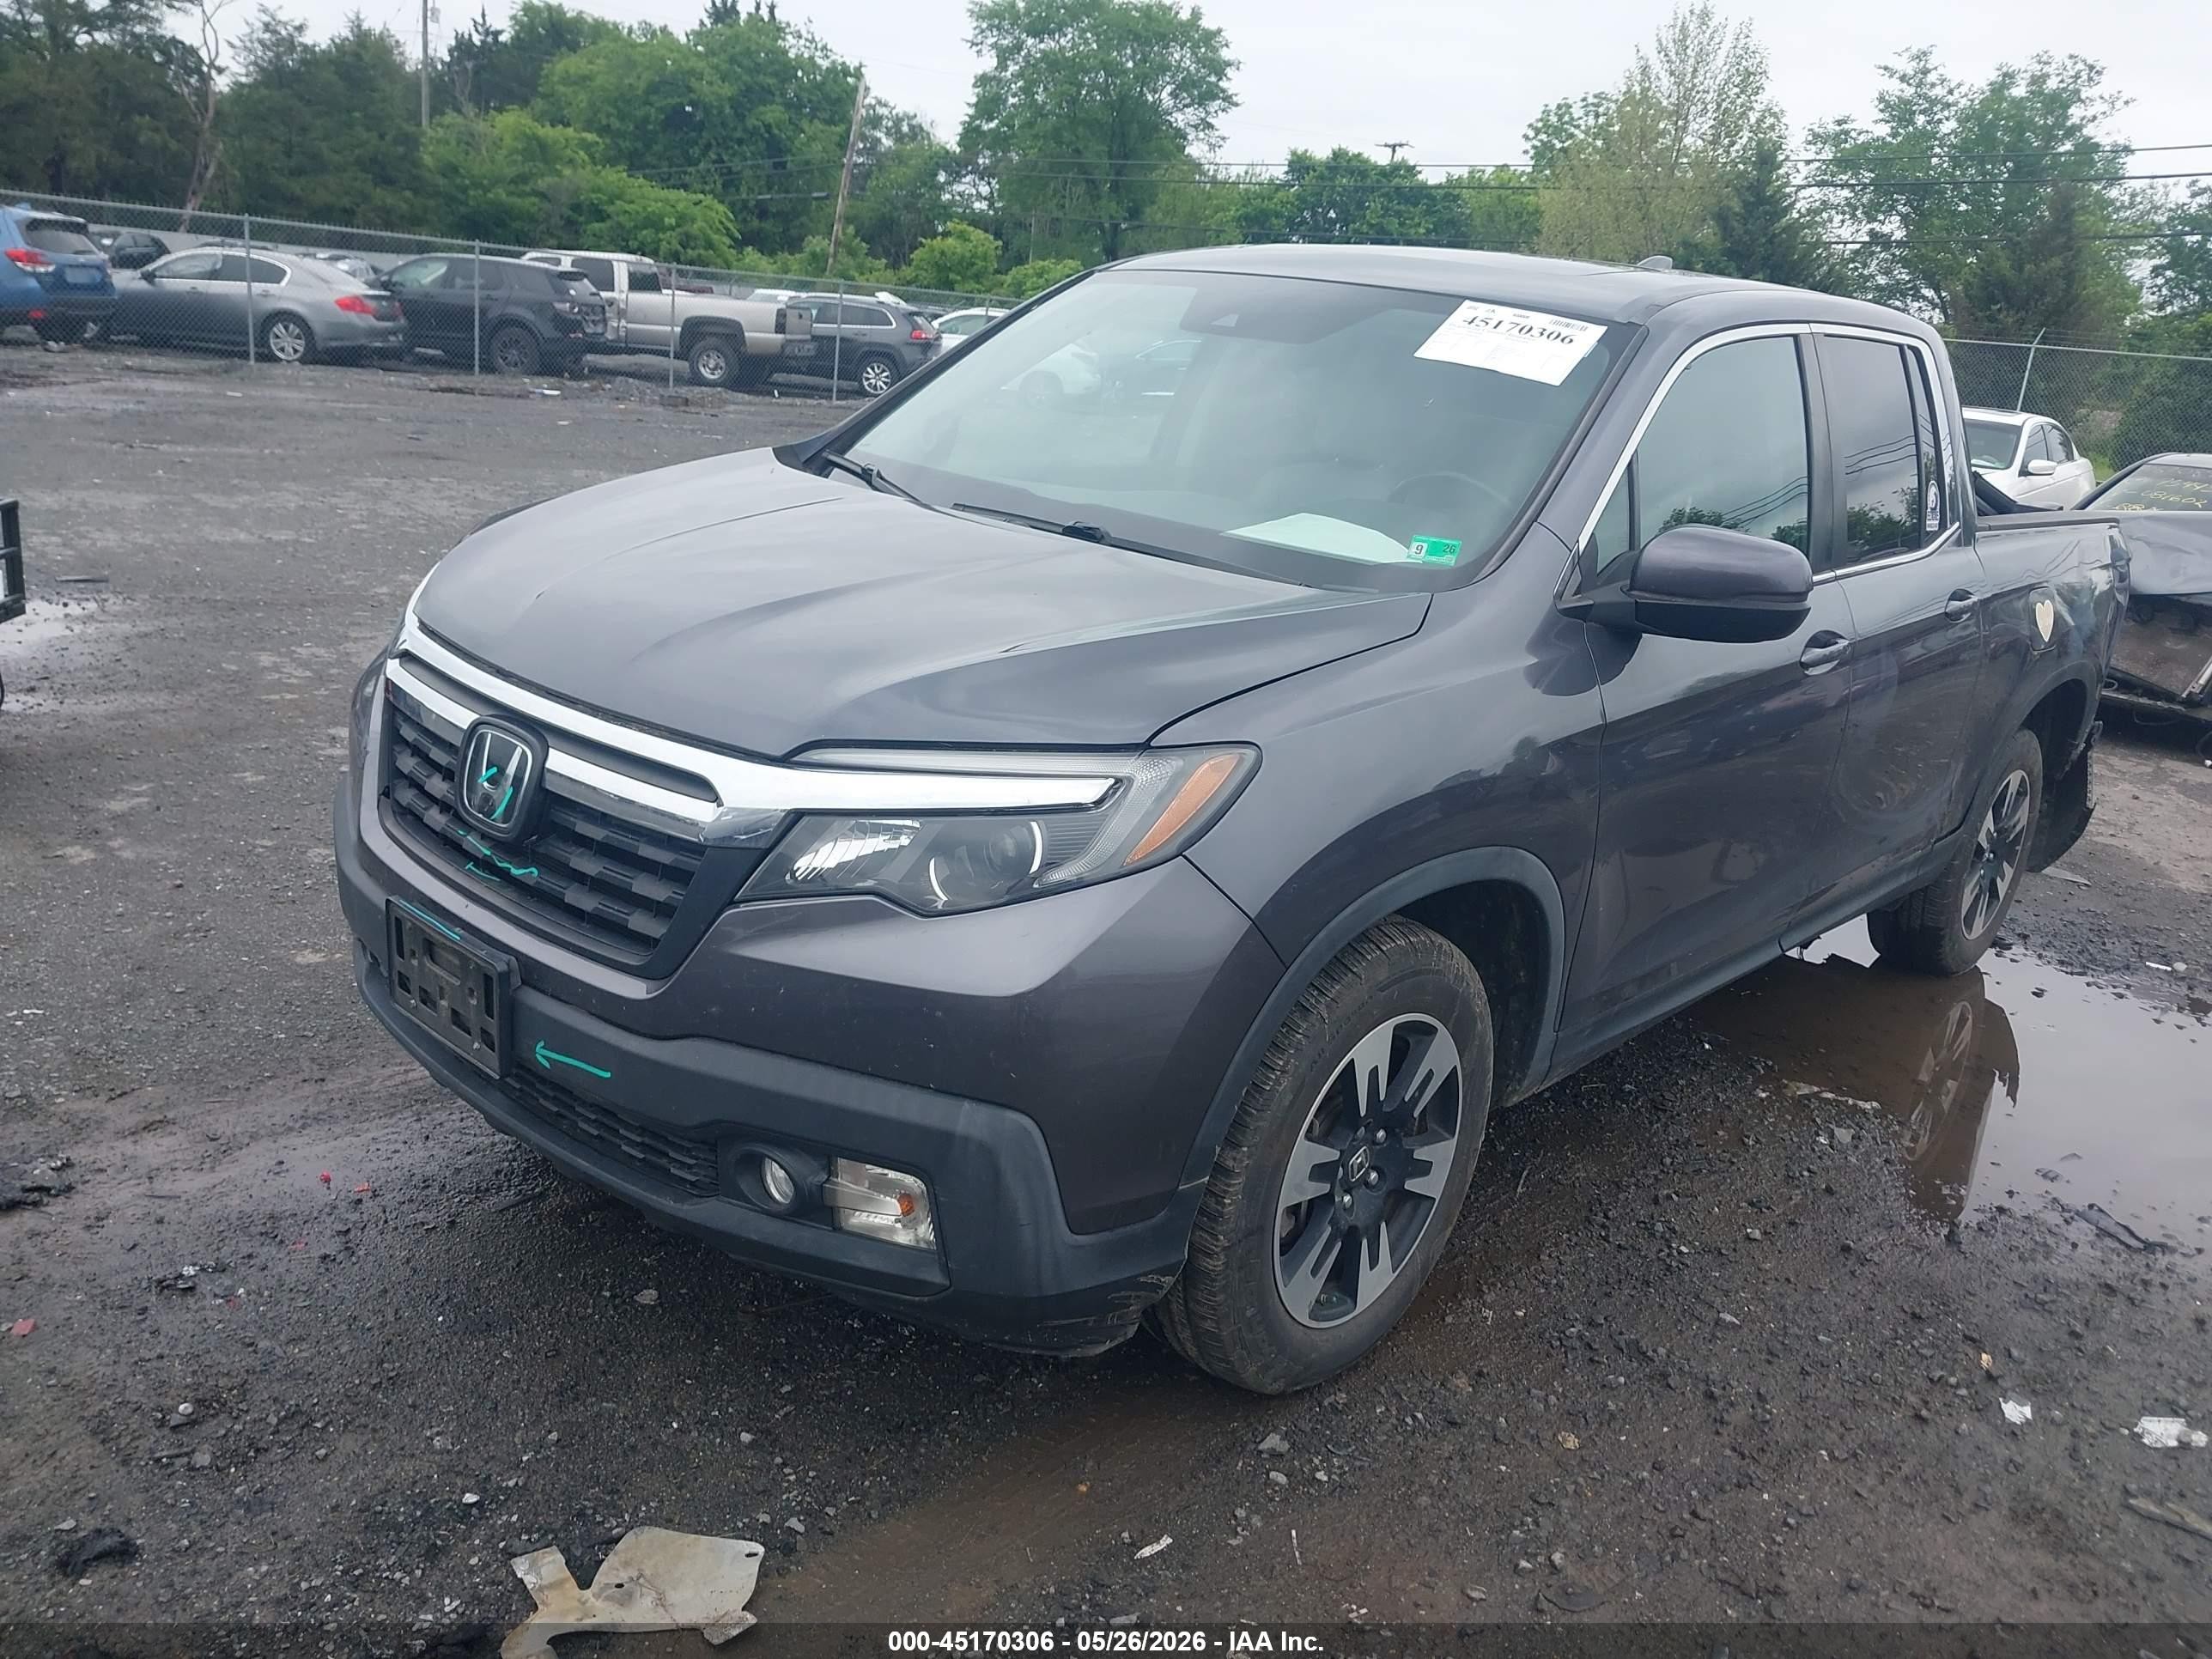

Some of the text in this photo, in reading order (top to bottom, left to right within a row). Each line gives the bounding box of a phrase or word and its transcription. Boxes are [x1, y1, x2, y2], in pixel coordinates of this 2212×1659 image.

[1462, 314, 1577, 344] 45170306
[1414, 543, 1457, 555] 9 26
